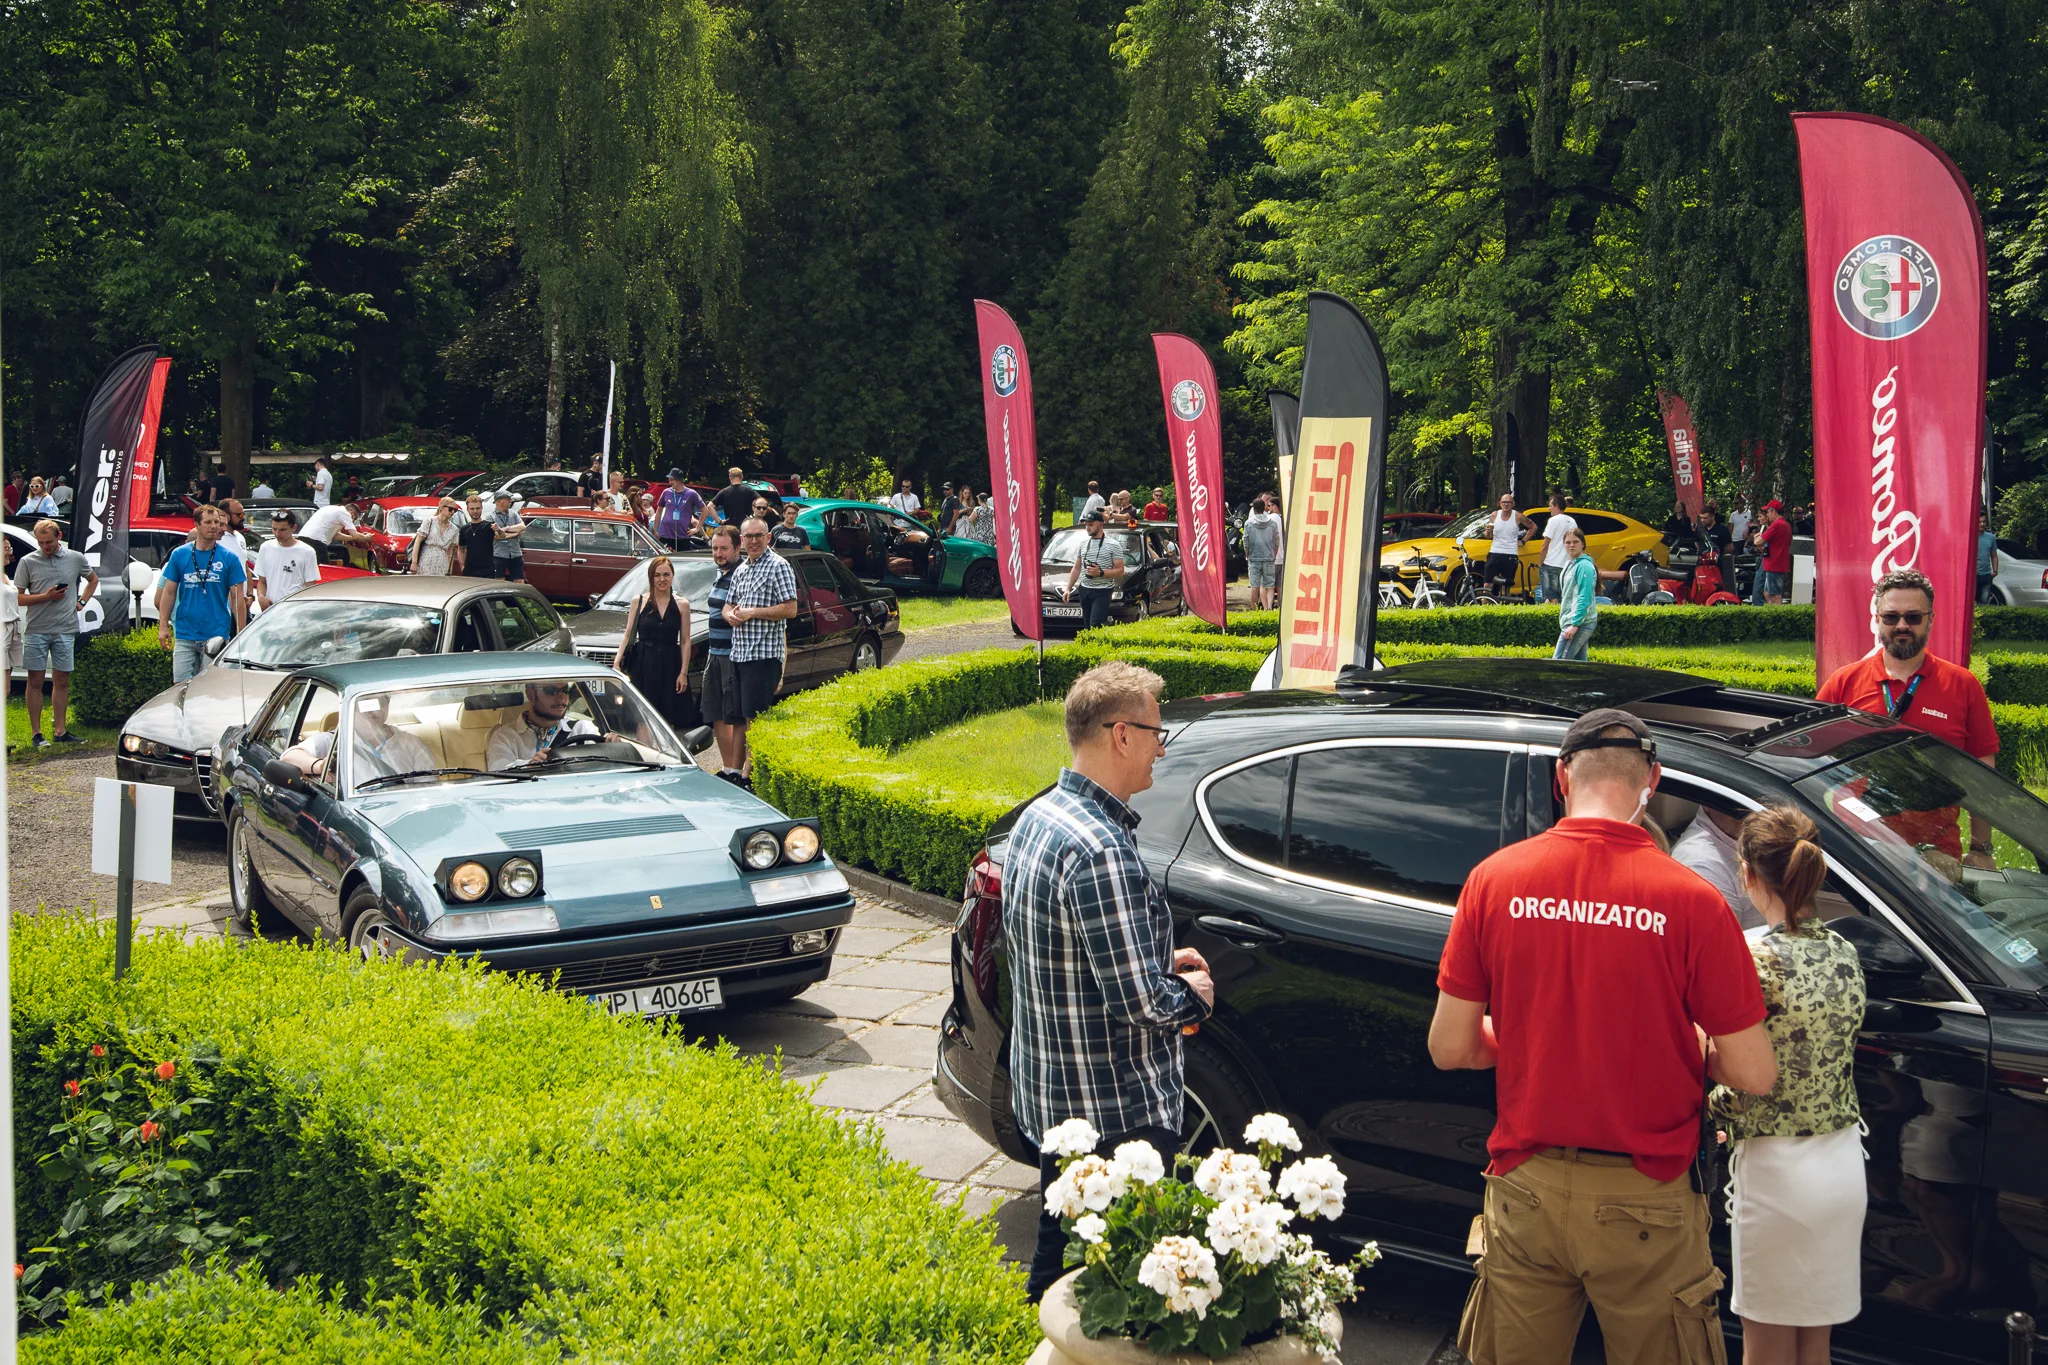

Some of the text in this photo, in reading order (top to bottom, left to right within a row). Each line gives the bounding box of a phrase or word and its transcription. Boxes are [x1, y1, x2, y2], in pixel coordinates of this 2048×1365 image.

[132, 473, 148, 482] ONIA
[134, 461, 150, 469] MEO
[106, 503, 116, 540] OPONY
[112, 450, 124, 491] SERWIS
[1508, 896, 1667, 936] ORGANIZATOR
[651, 979, 716, 1010] 4066F
